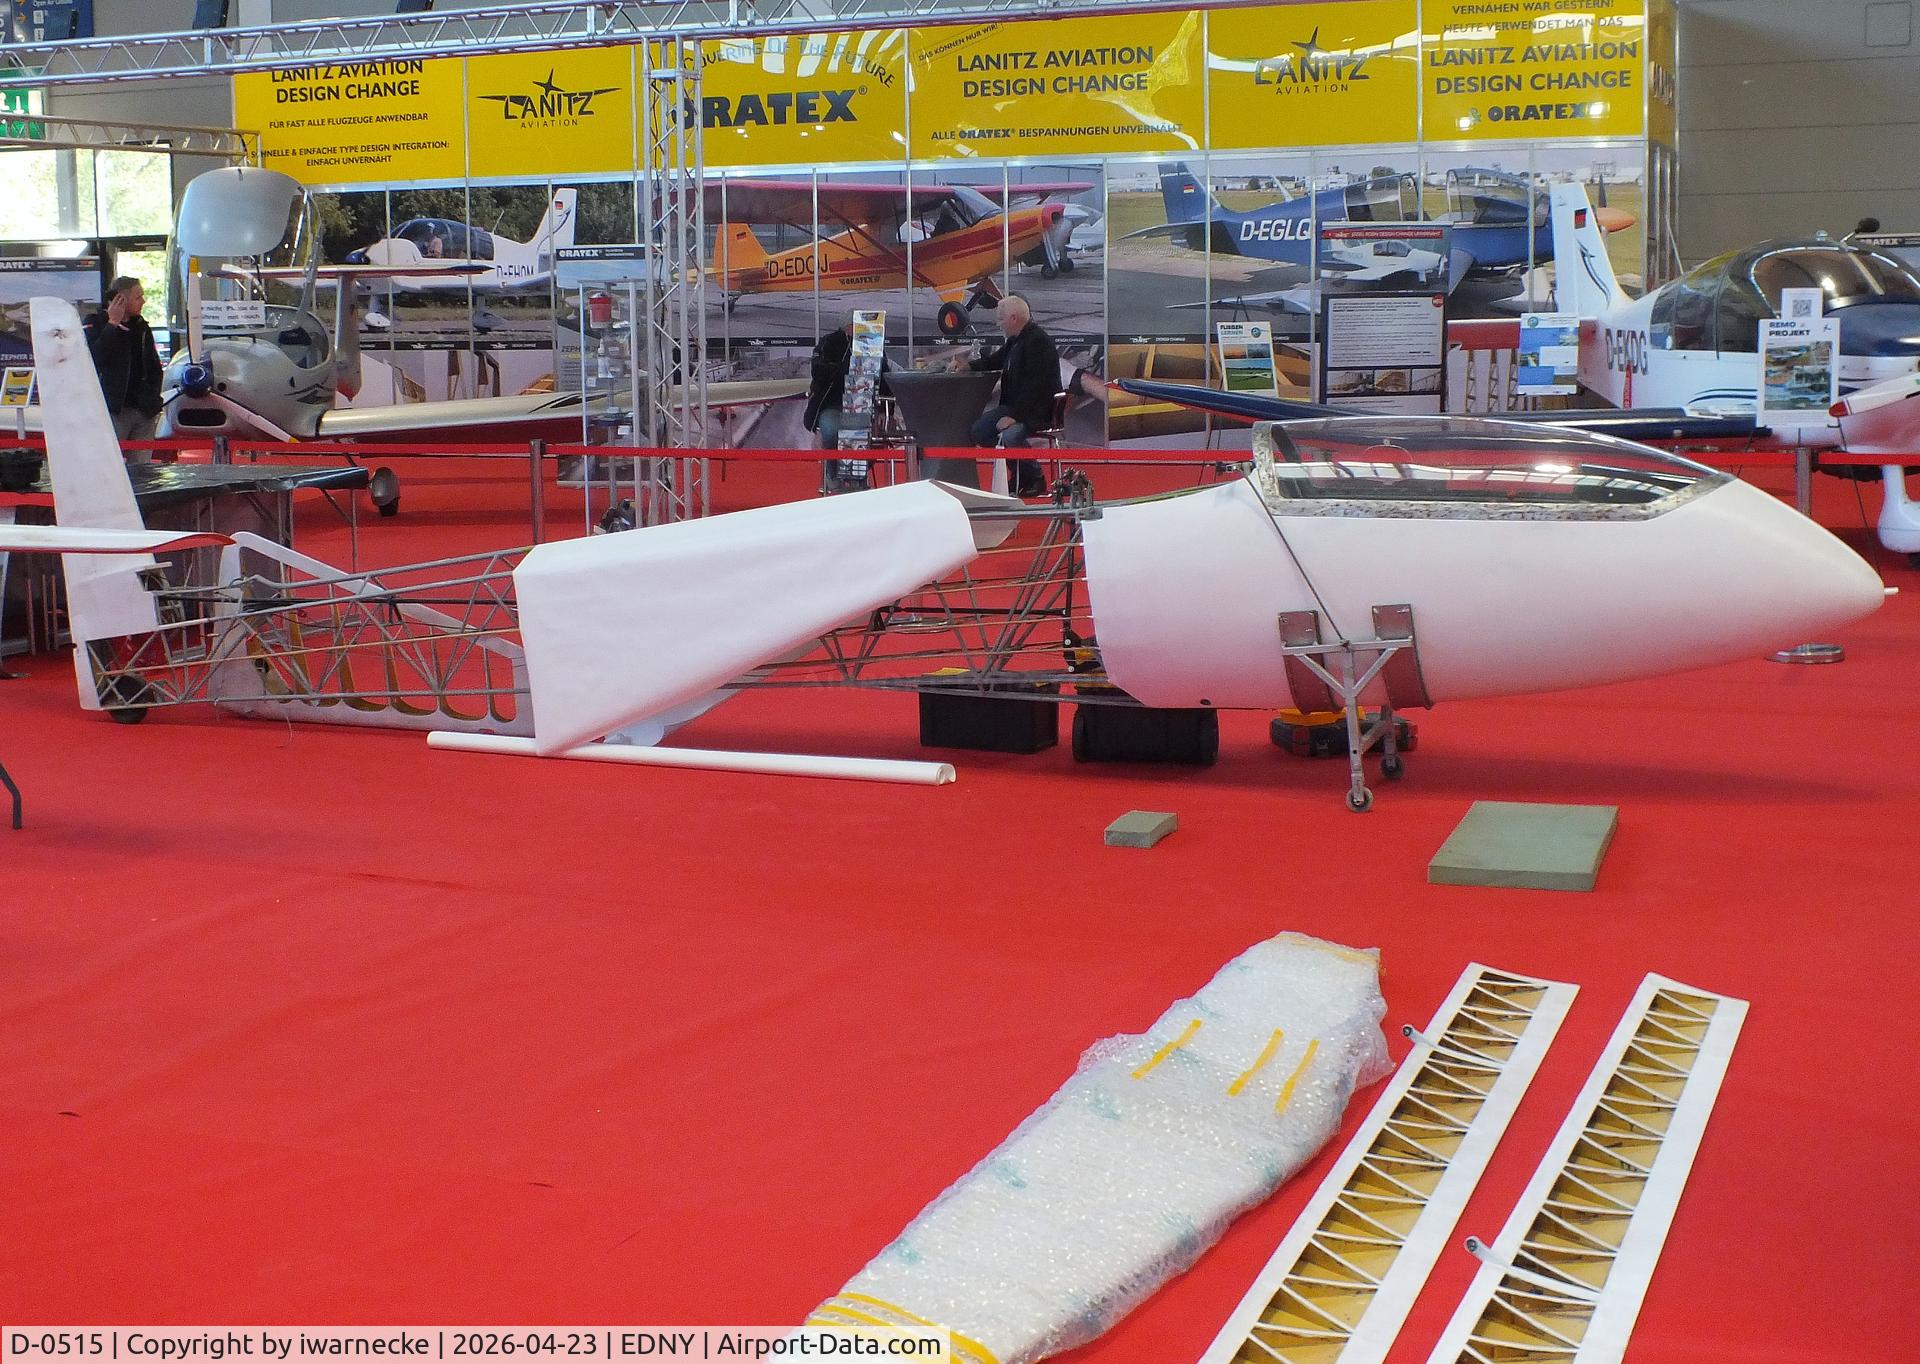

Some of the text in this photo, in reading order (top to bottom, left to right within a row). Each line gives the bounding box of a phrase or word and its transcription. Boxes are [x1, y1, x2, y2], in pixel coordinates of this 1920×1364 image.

[1524, 2, 1550, 12] WAR
[1487, 19, 1561, 31] VERWENDET
[1565, 18, 1594, 28] MAN
[1599, 17, 1623, 26] DAS
[957, 46, 1154, 72] LANITZ AVIATION
[1430, 42, 1637, 67] LANITZ AVIATION
[338, 59, 424, 78] AVIATION
[1255, 53, 1370, 85] LANITZ
[963, 73, 1149, 97] DESIGN CHANGE
[1276, 84, 1349, 95] AVIATION
[1436, 74, 1522, 94] DESIGN
[1530, 70, 1632, 90] CHANGE
[276, 80, 421, 104] DESIGN CHANGE
[503, 90, 596, 120] LANITZ
[286, 119, 306, 128] FAST
[307, 118, 327, 127] ALLE
[327, 115, 374, 126] FLUGZEUGE
[375, 112, 429, 124] ANWENDBAR
[520, 119, 579, 129] AVIATION
[931, 131, 955, 141] ALLE
[1019, 126, 1110, 138] BESPANNUNGEN
[251, 148, 290, 158] SHNELLE
[299, 146, 337, 156] EINFACHE
[339, 145, 360, 154] TYPE
[360, 142, 391, 153] DESIGN
[306, 157, 341, 167] EINFACH
[1768, 329, 1811, 337] PROJEKT
